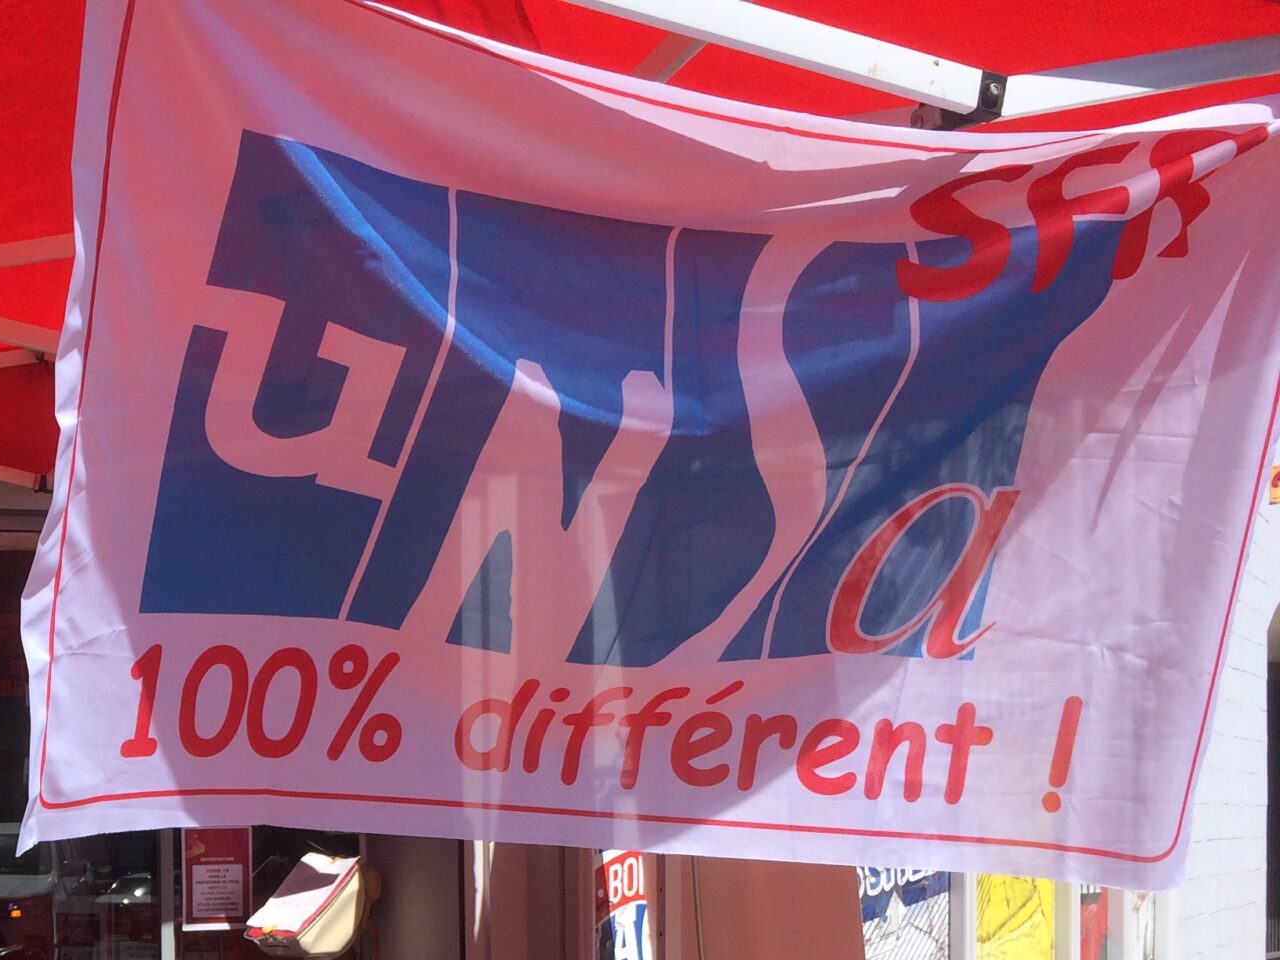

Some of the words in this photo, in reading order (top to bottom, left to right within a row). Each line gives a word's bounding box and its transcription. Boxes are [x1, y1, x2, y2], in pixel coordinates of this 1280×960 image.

[895, 126, 1266, 301] SFR
[119, 643, 403, 762] 100%
[454, 680, 993, 805] différent
